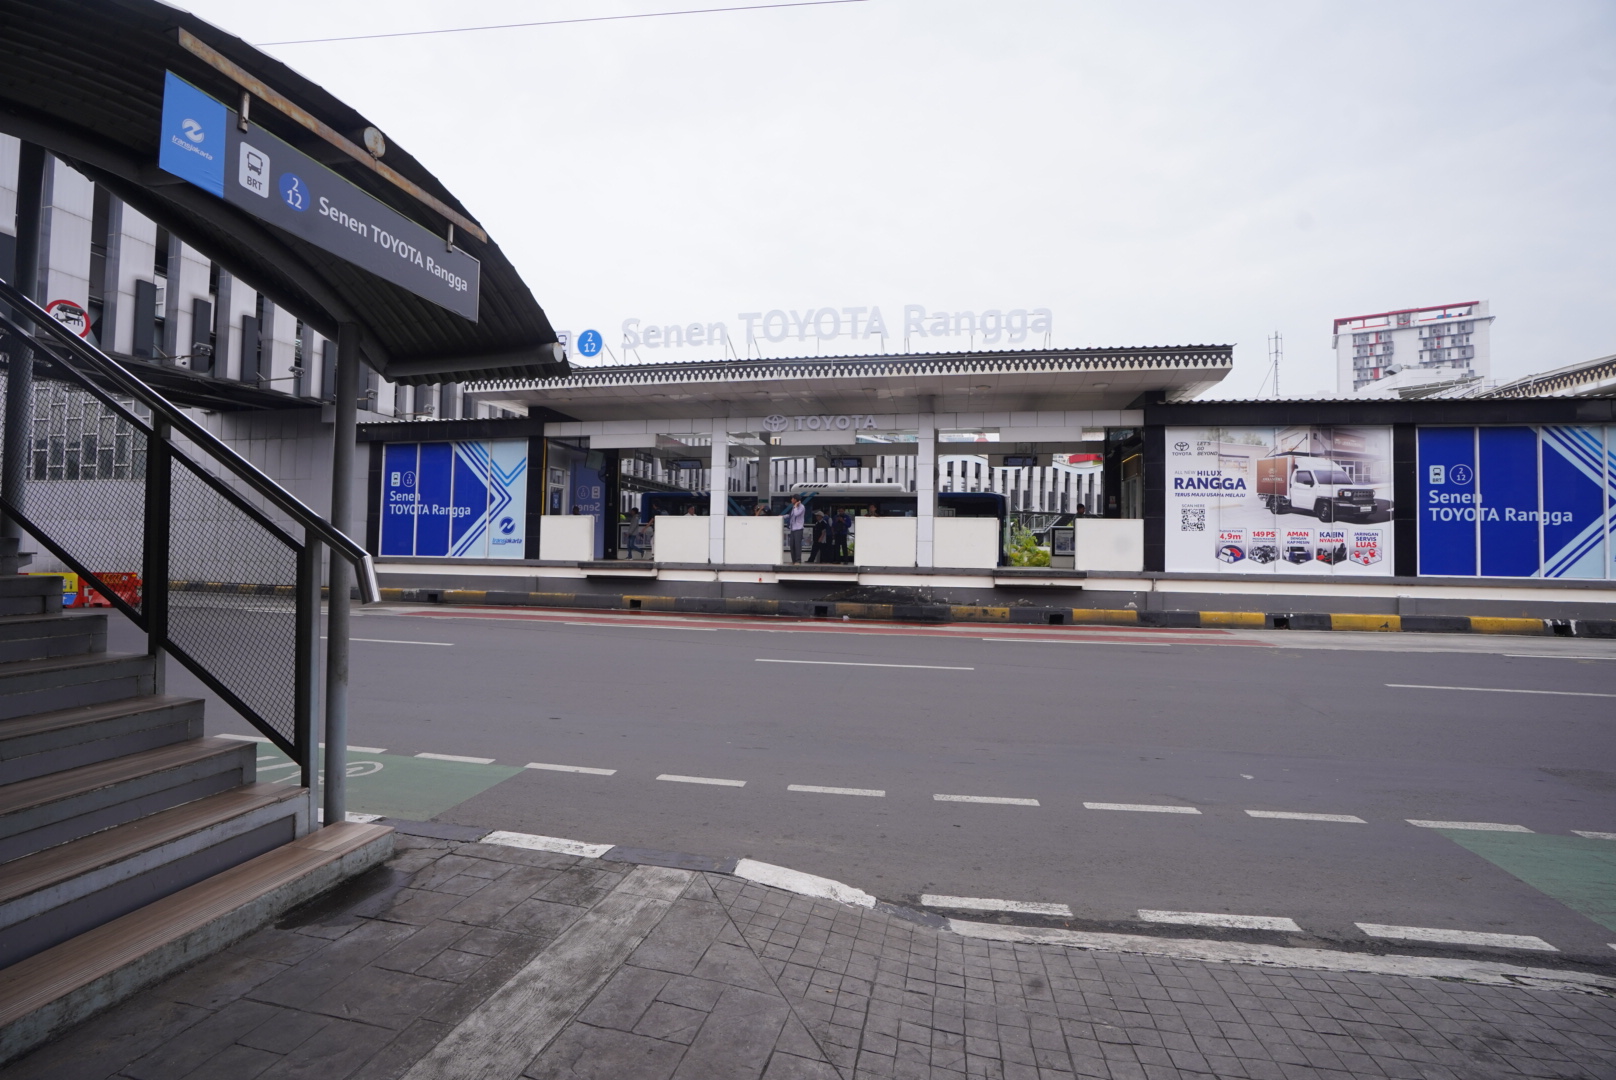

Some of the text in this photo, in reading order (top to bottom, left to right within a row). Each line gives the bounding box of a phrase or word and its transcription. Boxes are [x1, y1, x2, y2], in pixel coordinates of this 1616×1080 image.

[171, 134, 213, 160] transjakarta
[246, 176, 262, 191] BRT
[291, 177, 299, 192] 2
[287, 190, 302, 209] 12
[318, 196, 468, 292] Senen TOYOTA Rangga
[621, 303, 1053, 349] Senen TOYOTA Rangga
[587, 332, 593, 342] 2
[584, 342, 596, 353] 12
[794, 415, 878, 431] TOYOTA
[1174, 477, 1247, 490] RANGGA
[1428, 489, 1483, 504] Senen
[389, 504, 471, 518] TOYOTA Rangga
[1428, 507, 1573, 526] TOYOTA Rangga
